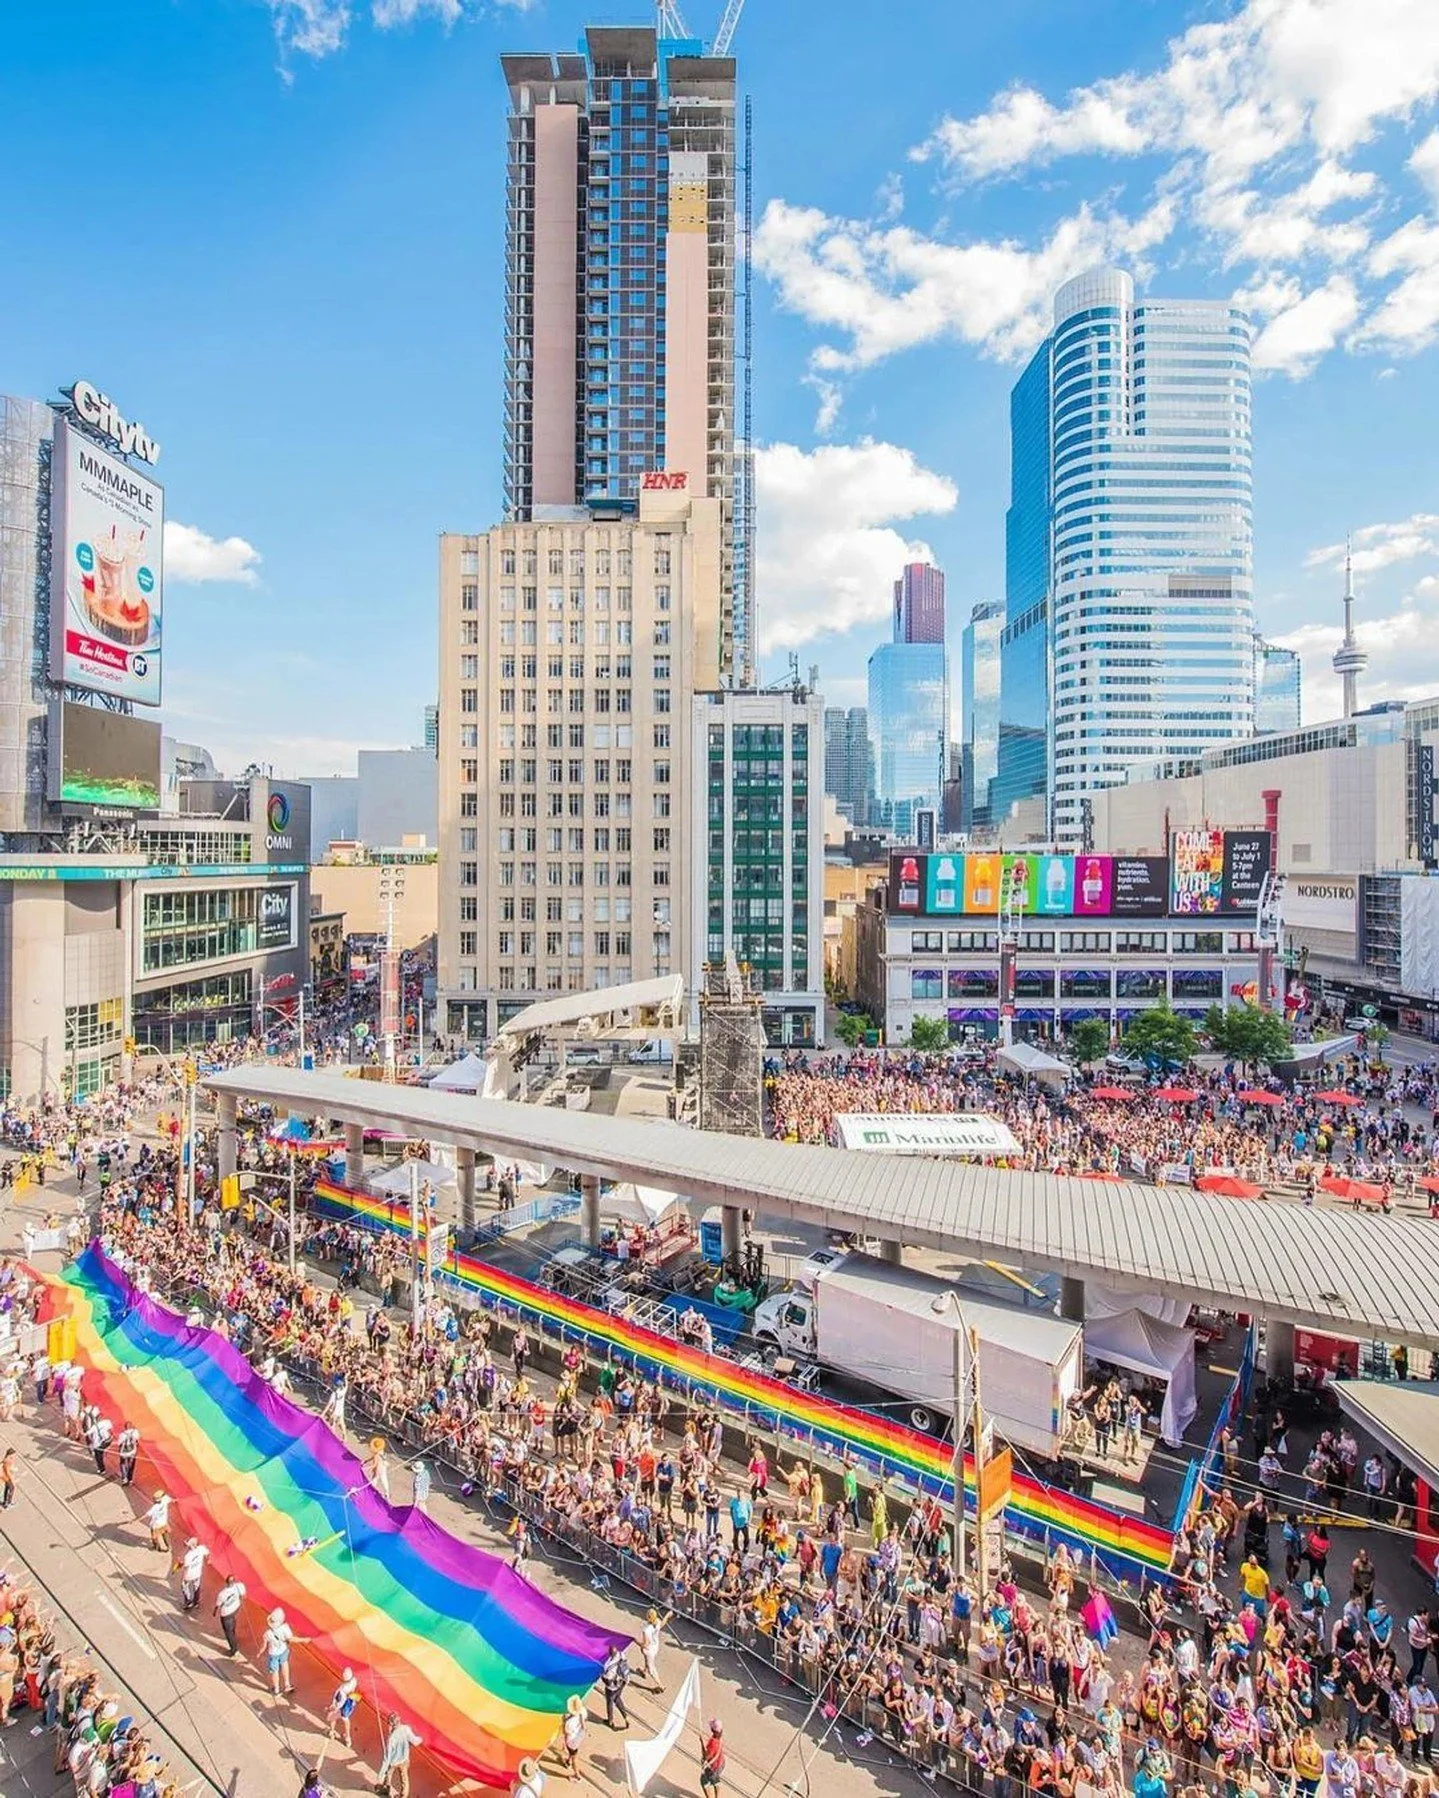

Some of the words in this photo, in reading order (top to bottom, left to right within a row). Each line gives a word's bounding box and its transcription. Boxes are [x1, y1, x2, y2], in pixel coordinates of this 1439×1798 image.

[74, 381, 160, 465] Citytv
[79, 451, 154, 512] MMMAPLE
[642, 472, 688, 489] HNR
[1421, 750, 1433, 857] NORDSTROM
[93, 807, 134, 818] Panasonic
[266, 836, 293, 850] OMNI
[1176, 831, 1214, 851] COME
[1232, 842, 1250, 851] June
[1241, 852, 1256, 861] July
[1232, 862, 1253, 871] 5-7pm
[1174, 872, 1210, 892] WITH
[1231, 881, 1260, 889] Canteen
[1297, 885, 1355, 899] NORDSTRO
[262, 893, 288, 917] City
[1173, 891, 1191, 912] US
[895, 1131, 997, 1145] Manulife
